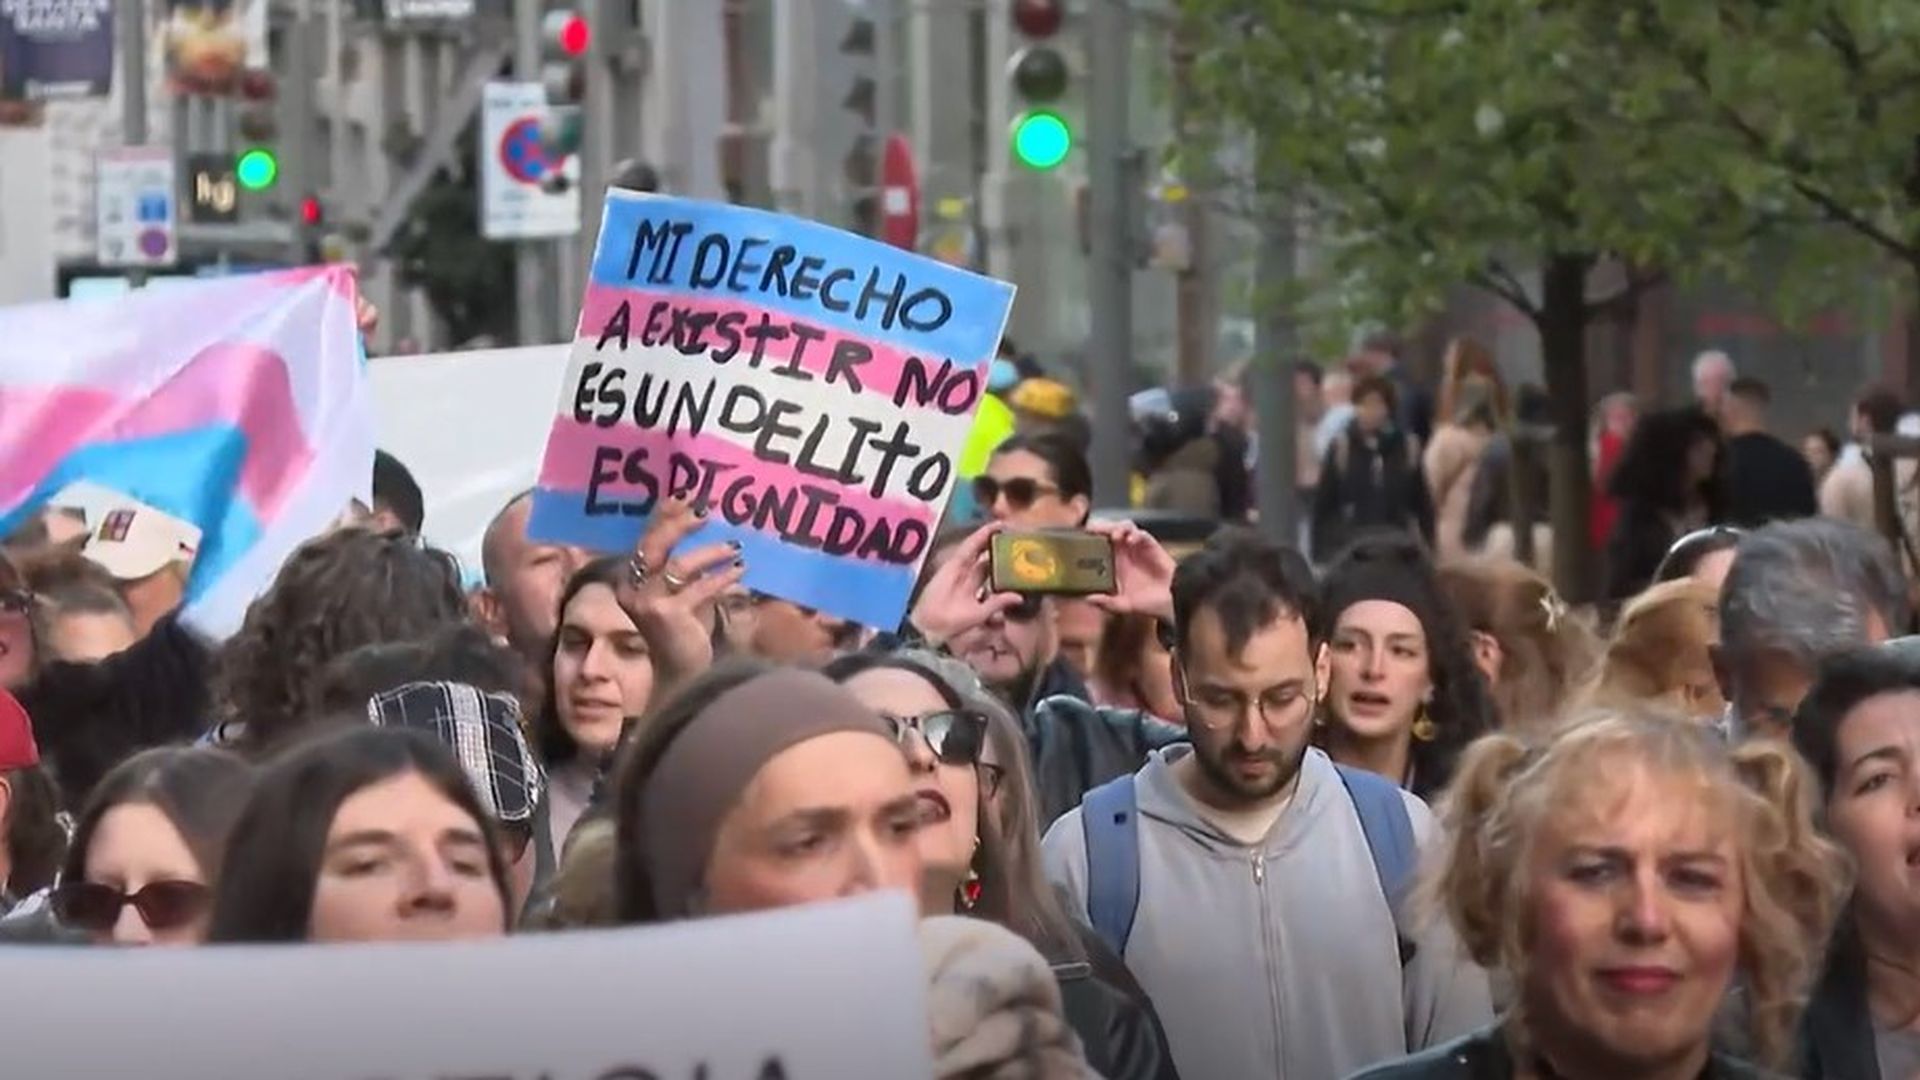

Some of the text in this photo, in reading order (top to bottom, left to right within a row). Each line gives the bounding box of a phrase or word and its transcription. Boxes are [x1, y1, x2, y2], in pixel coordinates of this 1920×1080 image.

[626, 218, 952, 332] MI DERECHO
[573, 363, 627, 427] ES
[633, 373, 716, 438] UN
[596, 301, 629, 352] A
[892, 357, 978, 416] NO
[584, 446, 928, 564] ES DIGNIDAD
